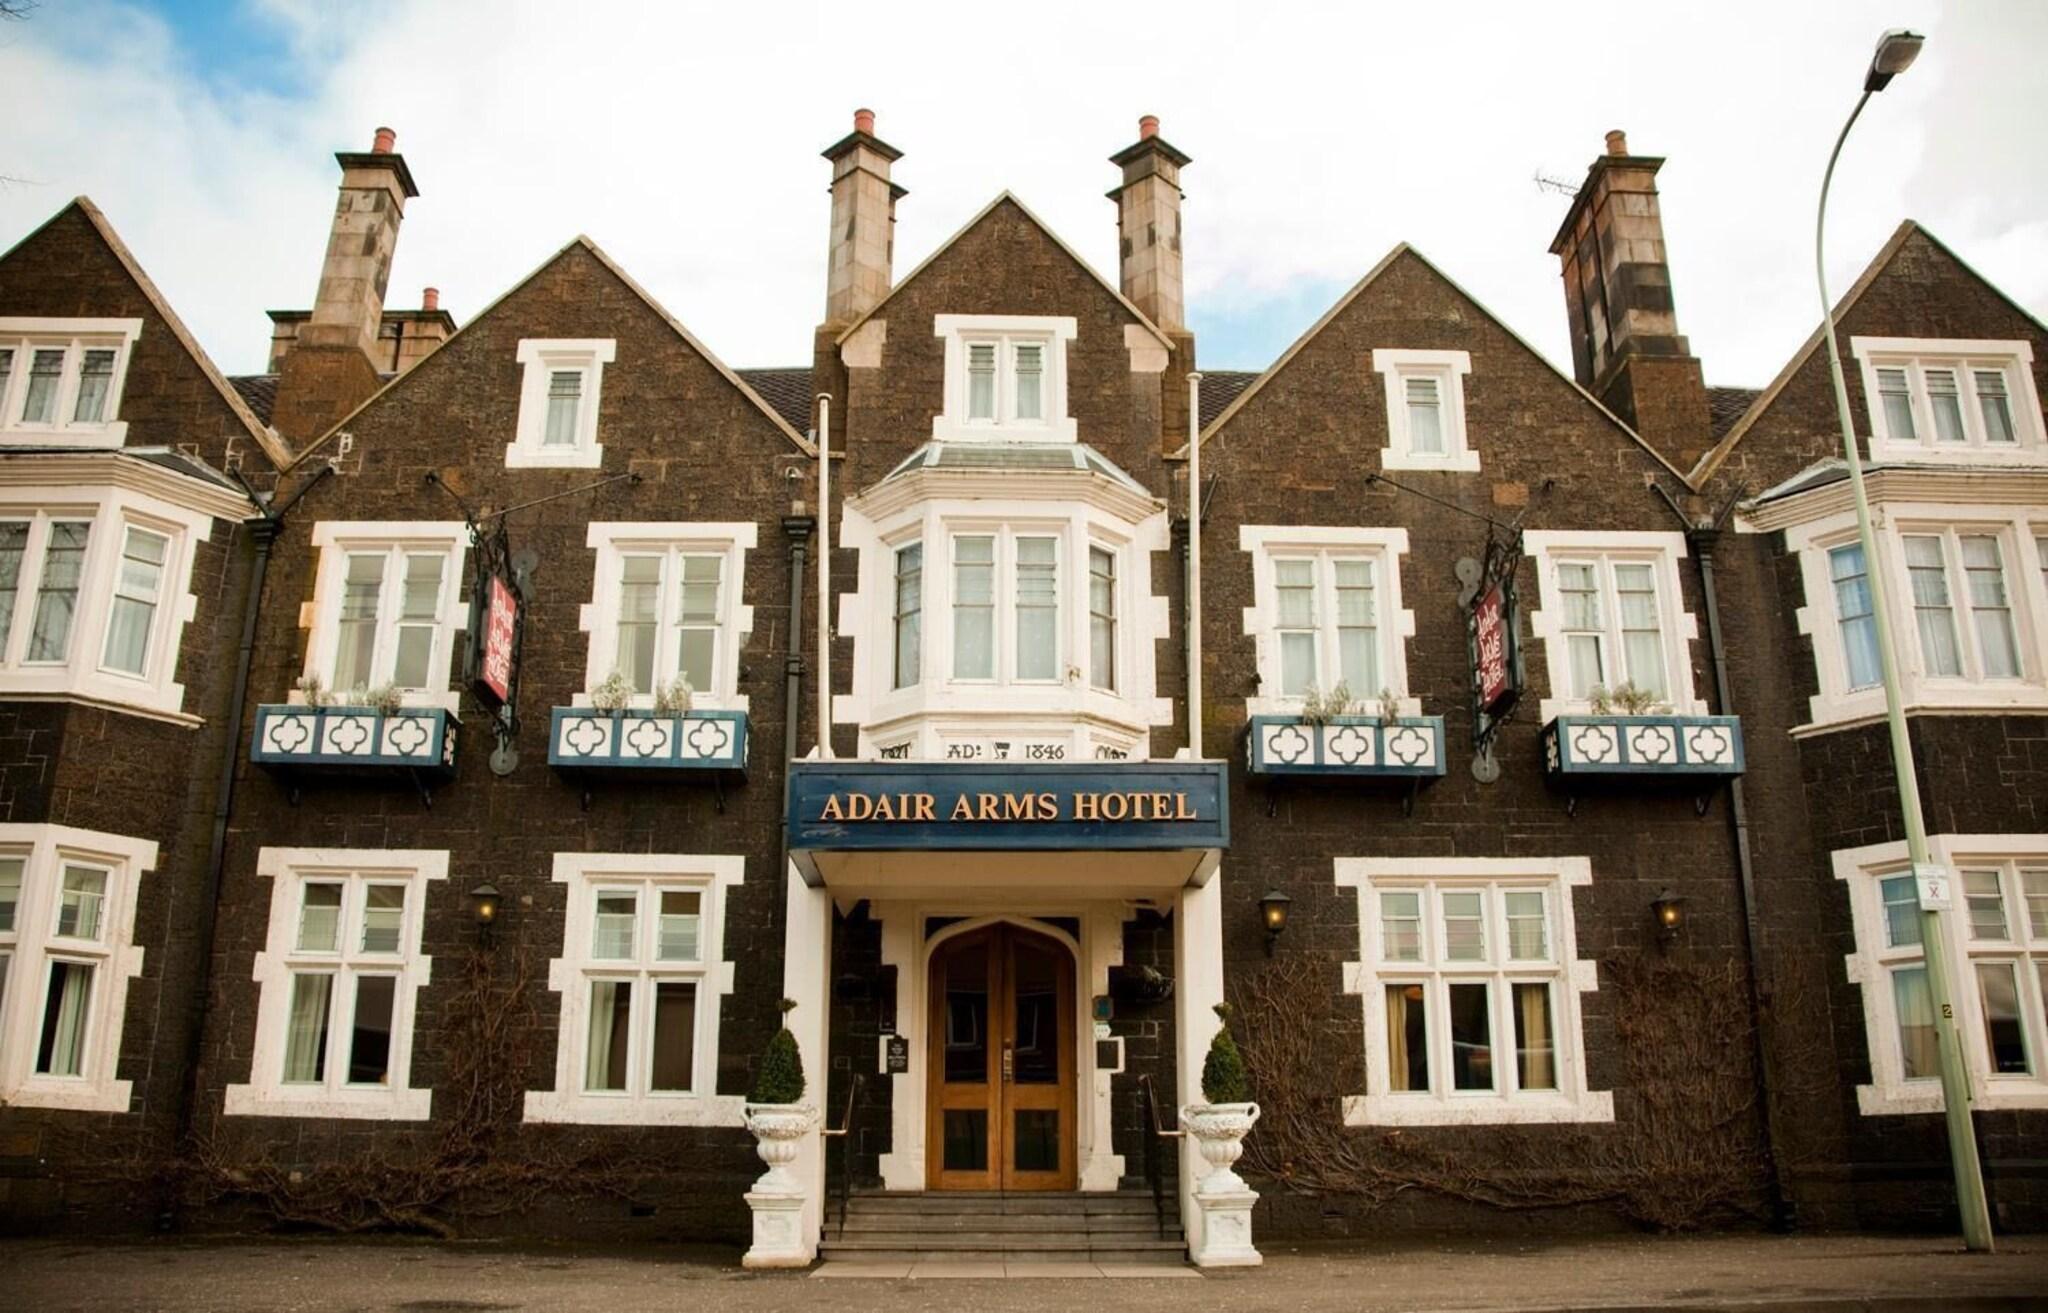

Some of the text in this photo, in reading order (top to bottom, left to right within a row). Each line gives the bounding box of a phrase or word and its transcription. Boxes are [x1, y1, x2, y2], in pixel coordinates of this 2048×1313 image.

[1025, 744, 1065, 760] 1846
[819, 793, 1198, 821] ADAIR ARMS HOTEL
[1943, 1005, 1952, 1017] 2
